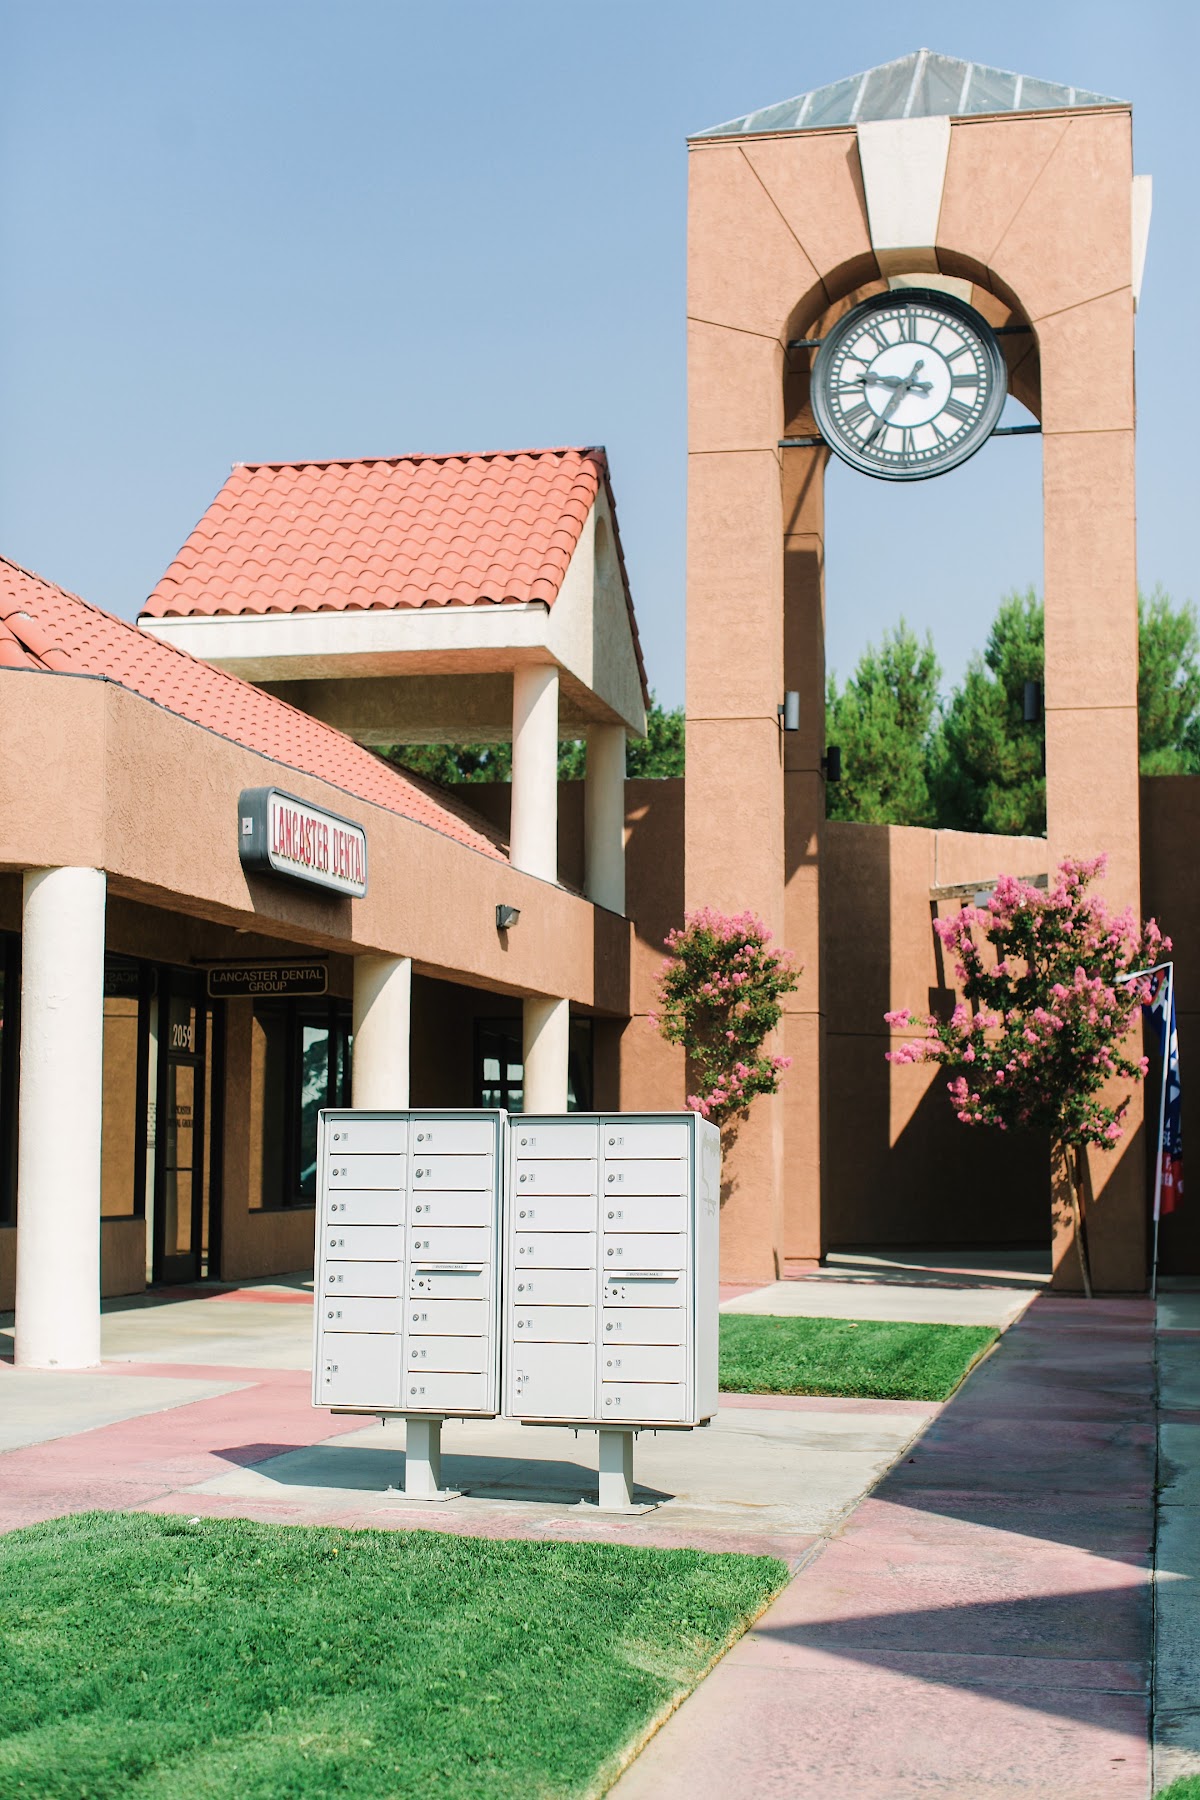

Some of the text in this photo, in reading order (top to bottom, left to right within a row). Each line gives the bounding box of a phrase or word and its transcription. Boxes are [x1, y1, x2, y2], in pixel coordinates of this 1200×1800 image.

[272, 803, 366, 883] LANCASTER DENTAL
[212, 969, 323, 983] LANCASTER DENTAL
[249, 981, 287, 992] GROUP
[172, 1023, 192, 1048] 2059
